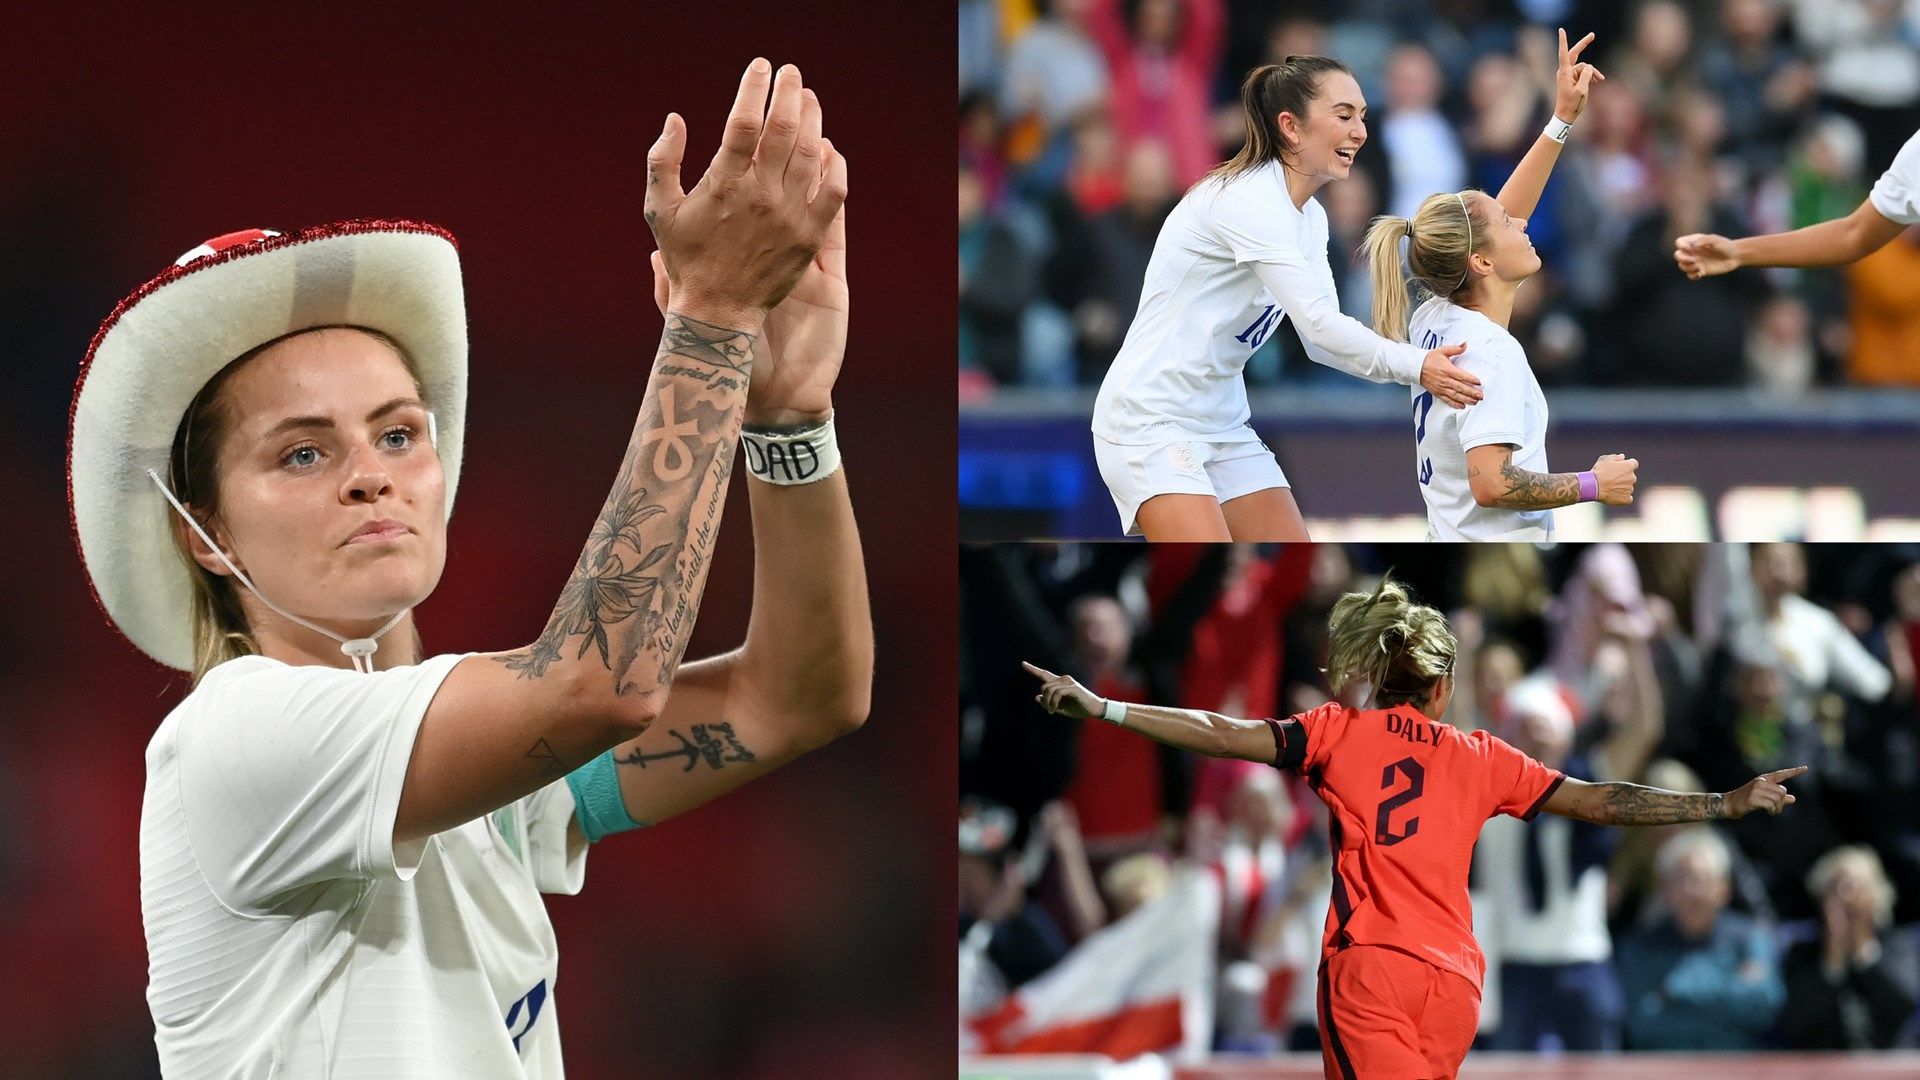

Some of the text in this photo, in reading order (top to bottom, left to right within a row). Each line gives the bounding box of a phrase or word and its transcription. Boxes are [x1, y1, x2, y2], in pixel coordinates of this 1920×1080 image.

[1234, 304, 1282, 349] 18
[742, 436, 819, 481] DAD
[665, 592, 687, 635] least
[684, 544, 703, 593] until
[695, 521, 711, 549] the
[1387, 713, 1443, 747] DALY
[1375, 756, 1425, 846] 2
